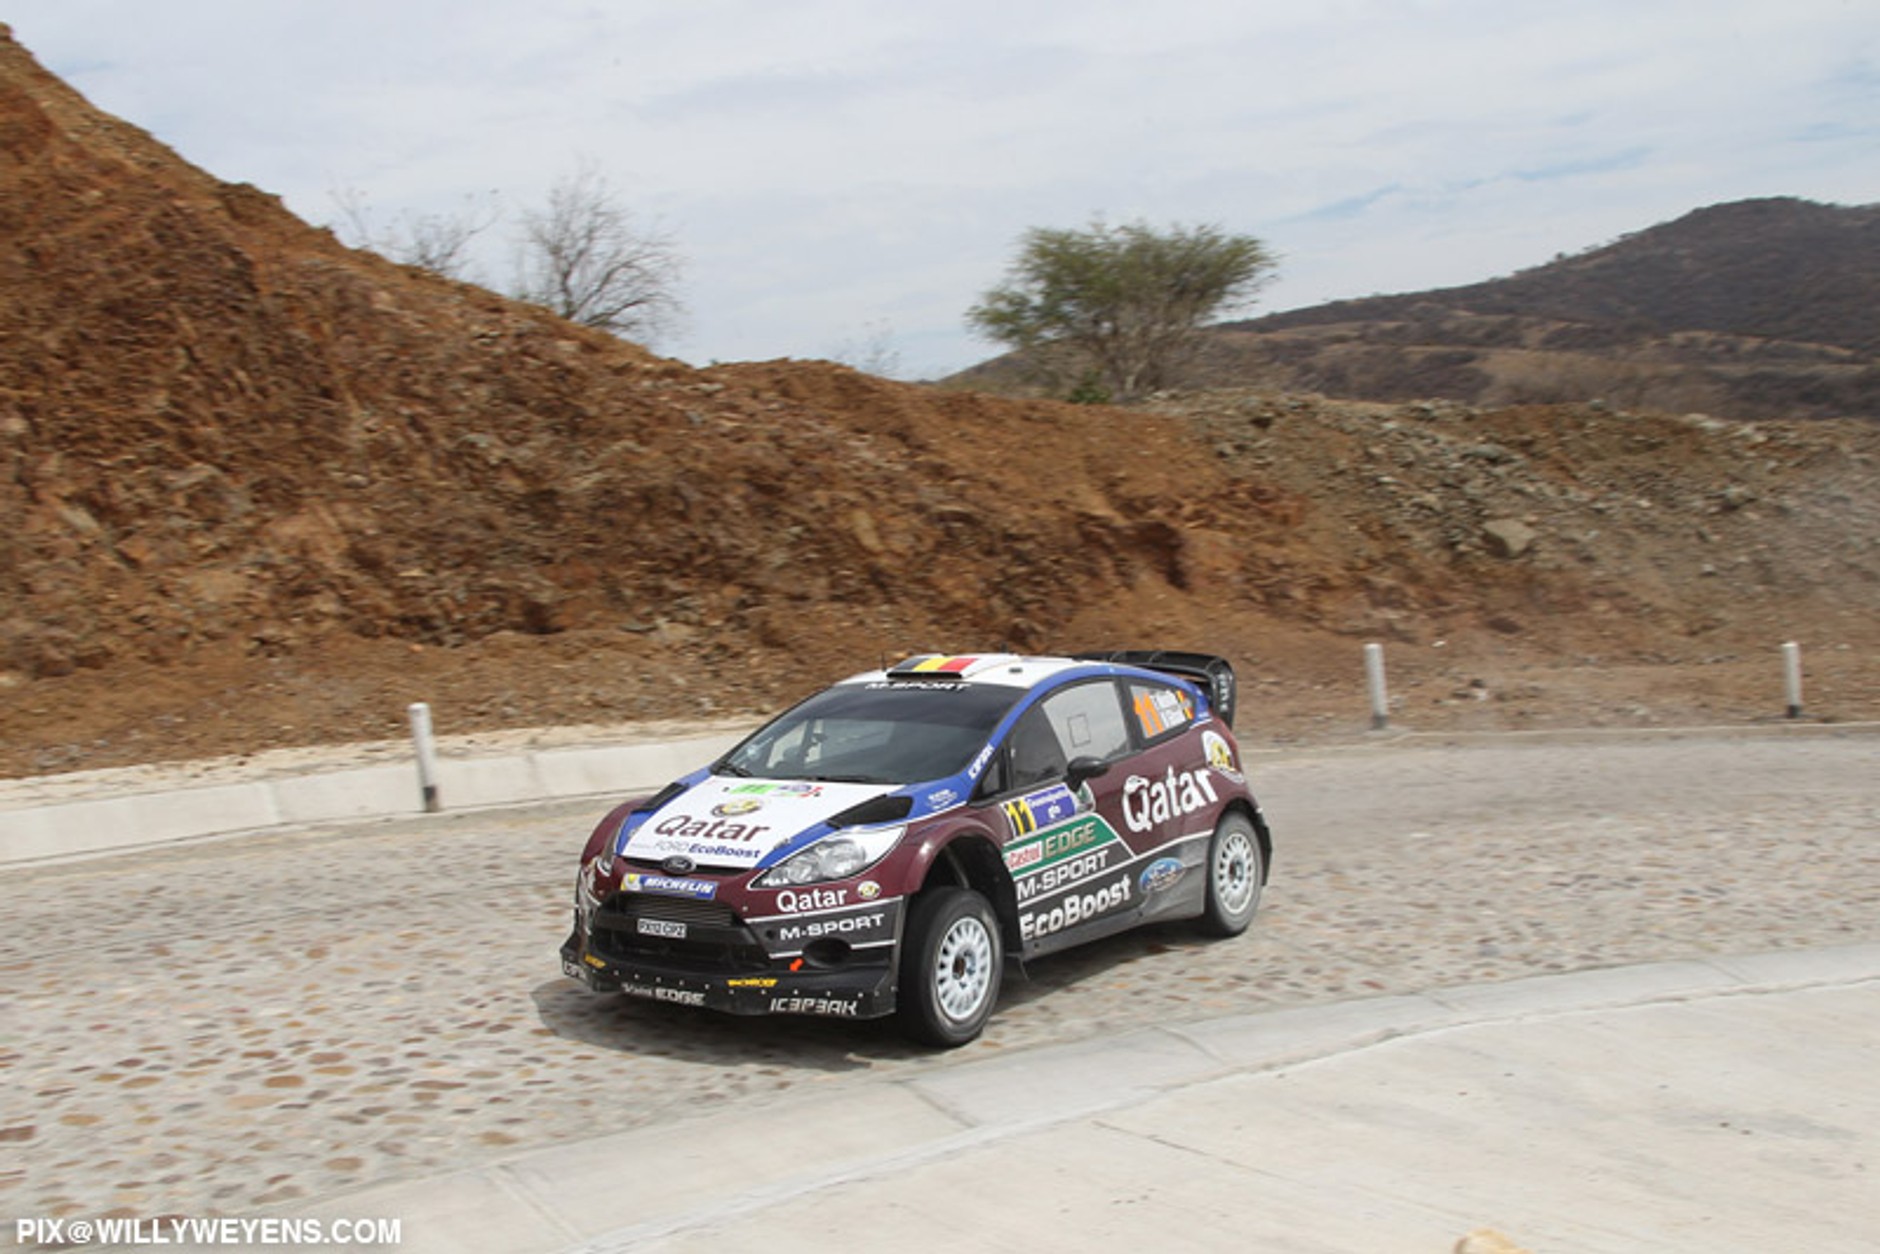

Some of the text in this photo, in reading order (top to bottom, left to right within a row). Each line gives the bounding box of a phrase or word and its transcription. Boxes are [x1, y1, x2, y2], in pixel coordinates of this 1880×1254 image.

[1133, 691, 1165, 737] 11
[1122, 764, 1219, 833] Qatar
[654, 815, 770, 842] Qatar
[1005, 800, 1037, 836] 11
[689, 843, 761, 858] EcoBoost
[1045, 821, 1097, 858] EDGE
[644, 876, 714, 894] MICHELIN
[1017, 849, 1109, 900] M-SPORT
[776, 888, 847, 912] Qatar
[1019, 873, 1132, 941] EcoBoost
[780, 913, 885, 940] M-SPORT
